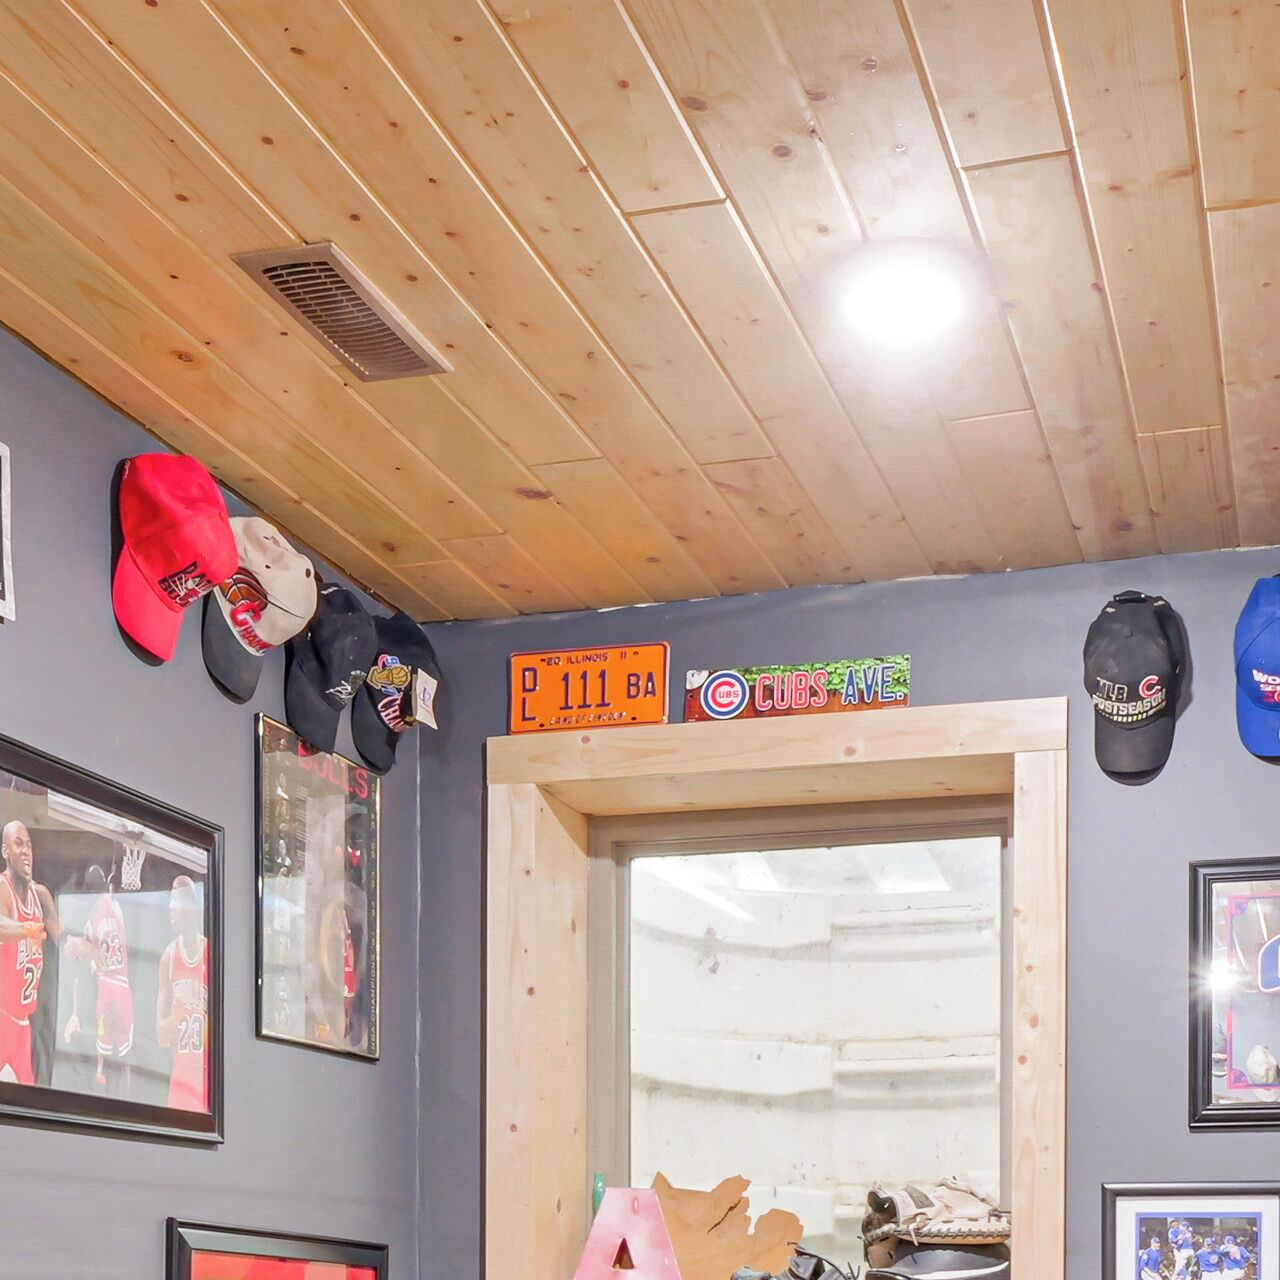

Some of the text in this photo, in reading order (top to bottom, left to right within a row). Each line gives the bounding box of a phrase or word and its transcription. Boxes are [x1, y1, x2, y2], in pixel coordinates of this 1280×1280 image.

[566, 652, 608, 665] ILLINOIS
[560, 668, 656, 710] 111 BA
[755, 663, 905, 711] CUBS AVE.
[1092, 688, 1166, 715] POSTSEASON
[1139, 675, 1161, 698] C
[178, 1014, 204, 1053] 23
